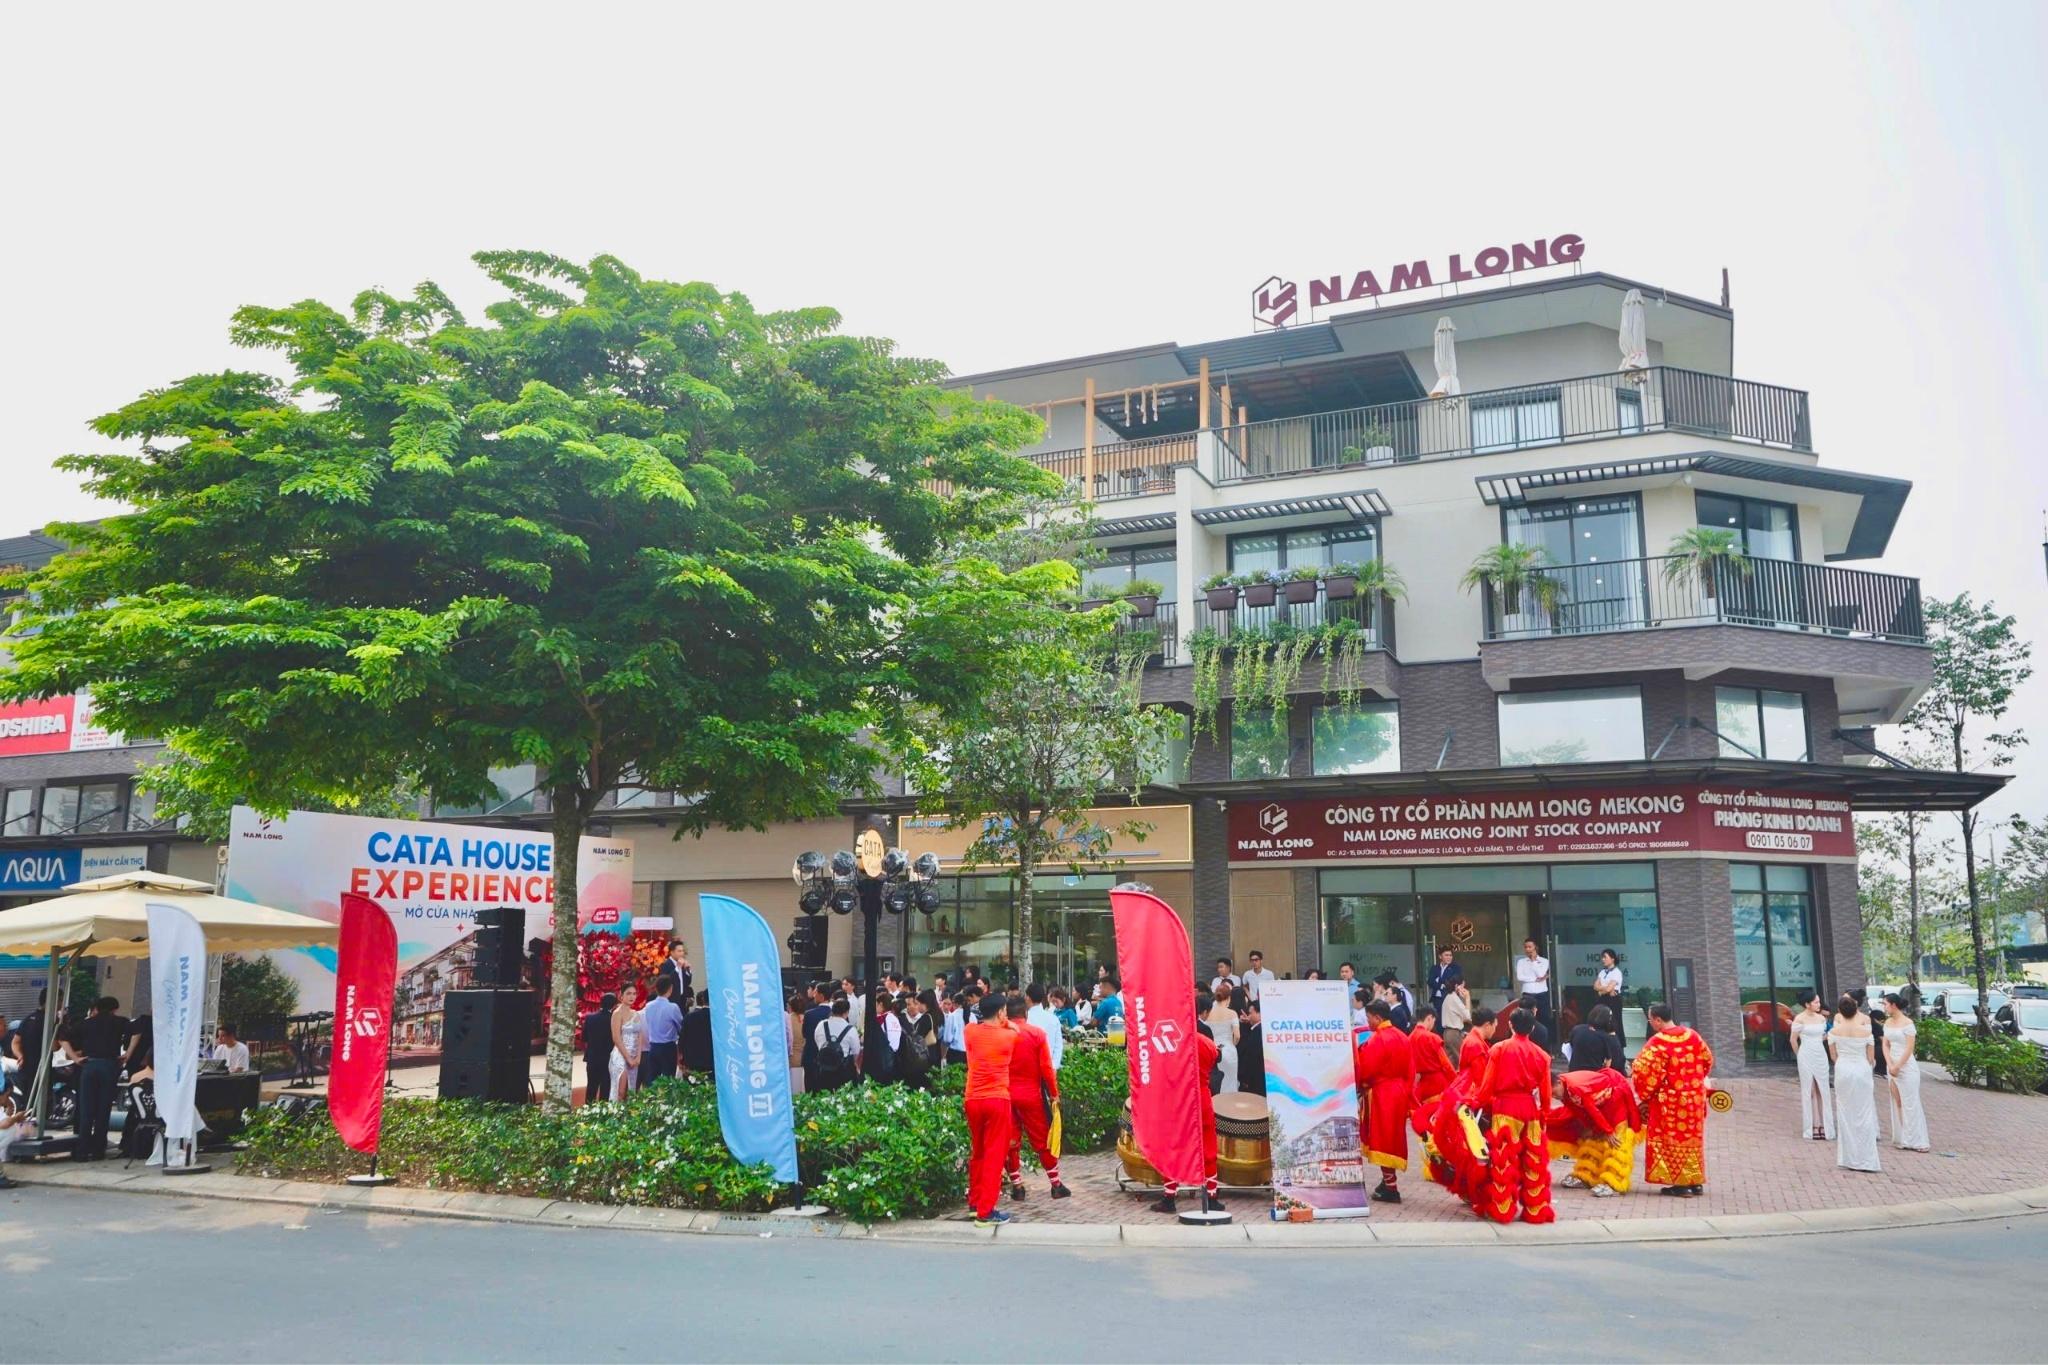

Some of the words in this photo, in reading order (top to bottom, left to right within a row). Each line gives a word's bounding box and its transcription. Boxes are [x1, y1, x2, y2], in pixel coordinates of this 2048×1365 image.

[1309, 260, 1432, 307] NAM
[1448, 233, 1586, 282] LONG
[1325, 804, 1375, 825] CÔNG
[1380, 806, 1400, 823] TY
[1405, 798, 1430, 822] CỔ
[1435, 798, 1486, 821] PHẦN
[1490, 801, 1533, 820] NAM
[1539, 799, 1592, 818] LONG
[1599, 795, 1685, 816] MEKONG
[1698, 790, 1722, 805] CÔNG
[1723, 793, 1733, 805] TY
[1771, 797, 1790, 809] NAM
[1791, 798, 1813, 810] LONG
[1815, 800, 1849, 812] MEKONG
[1344, 830, 1377, 842] NAM
[1380, 828, 1416, 841] LONG
[1421, 826, 1483, 841] MEKONG
[1488, 825, 1529, 839] JOINT
[1534, 823, 1580, 837] STOCK
[1584, 821, 1662, 836] COMPANY
[1713, 808, 1762, 828] PHÒNG
[1763, 813, 1794, 830] KINH
[1795, 815, 1842, 832] DOANH
[243, 831, 261, 840] NAM
[1238, 840, 1275, 849] NAM
[1276, 838, 1314, 849] LONG
[1750, 834, 1771, 847] 0901
[1774, 835, 1785, 847] 05
[1787, 836, 1798, 848] 06
[1801, 837, 1810, 849] 07
[368, 831, 453, 867] CATA
[462, 839, 551, 872] HOUSE
[864, 839, 882, 859] CATA
[1257, 849, 1293, 857] MEKONG
[4, 857, 66, 883] AQUA
[405, 904, 423, 919] MỞ
[426, 904, 449, 919] CỬA
[1462, 944, 1493, 952] LONG
[179, 956, 190, 1001] NAM
[742, 963, 761, 1018] NAM
[346, 985, 355, 1020] NAM
[1135, 996, 1147, 1037] NAM
[1270, 1020, 1303, 1030] CATA
[1305, 1019, 1344, 1030] HOUSE
[342, 1023, 352, 1061] LONG
[1266, 1032, 1349, 1043] EXPERIENCE
[746, 1025, 767, 1089] LONG
[1139, 1041, 1150, 1084] LONG
